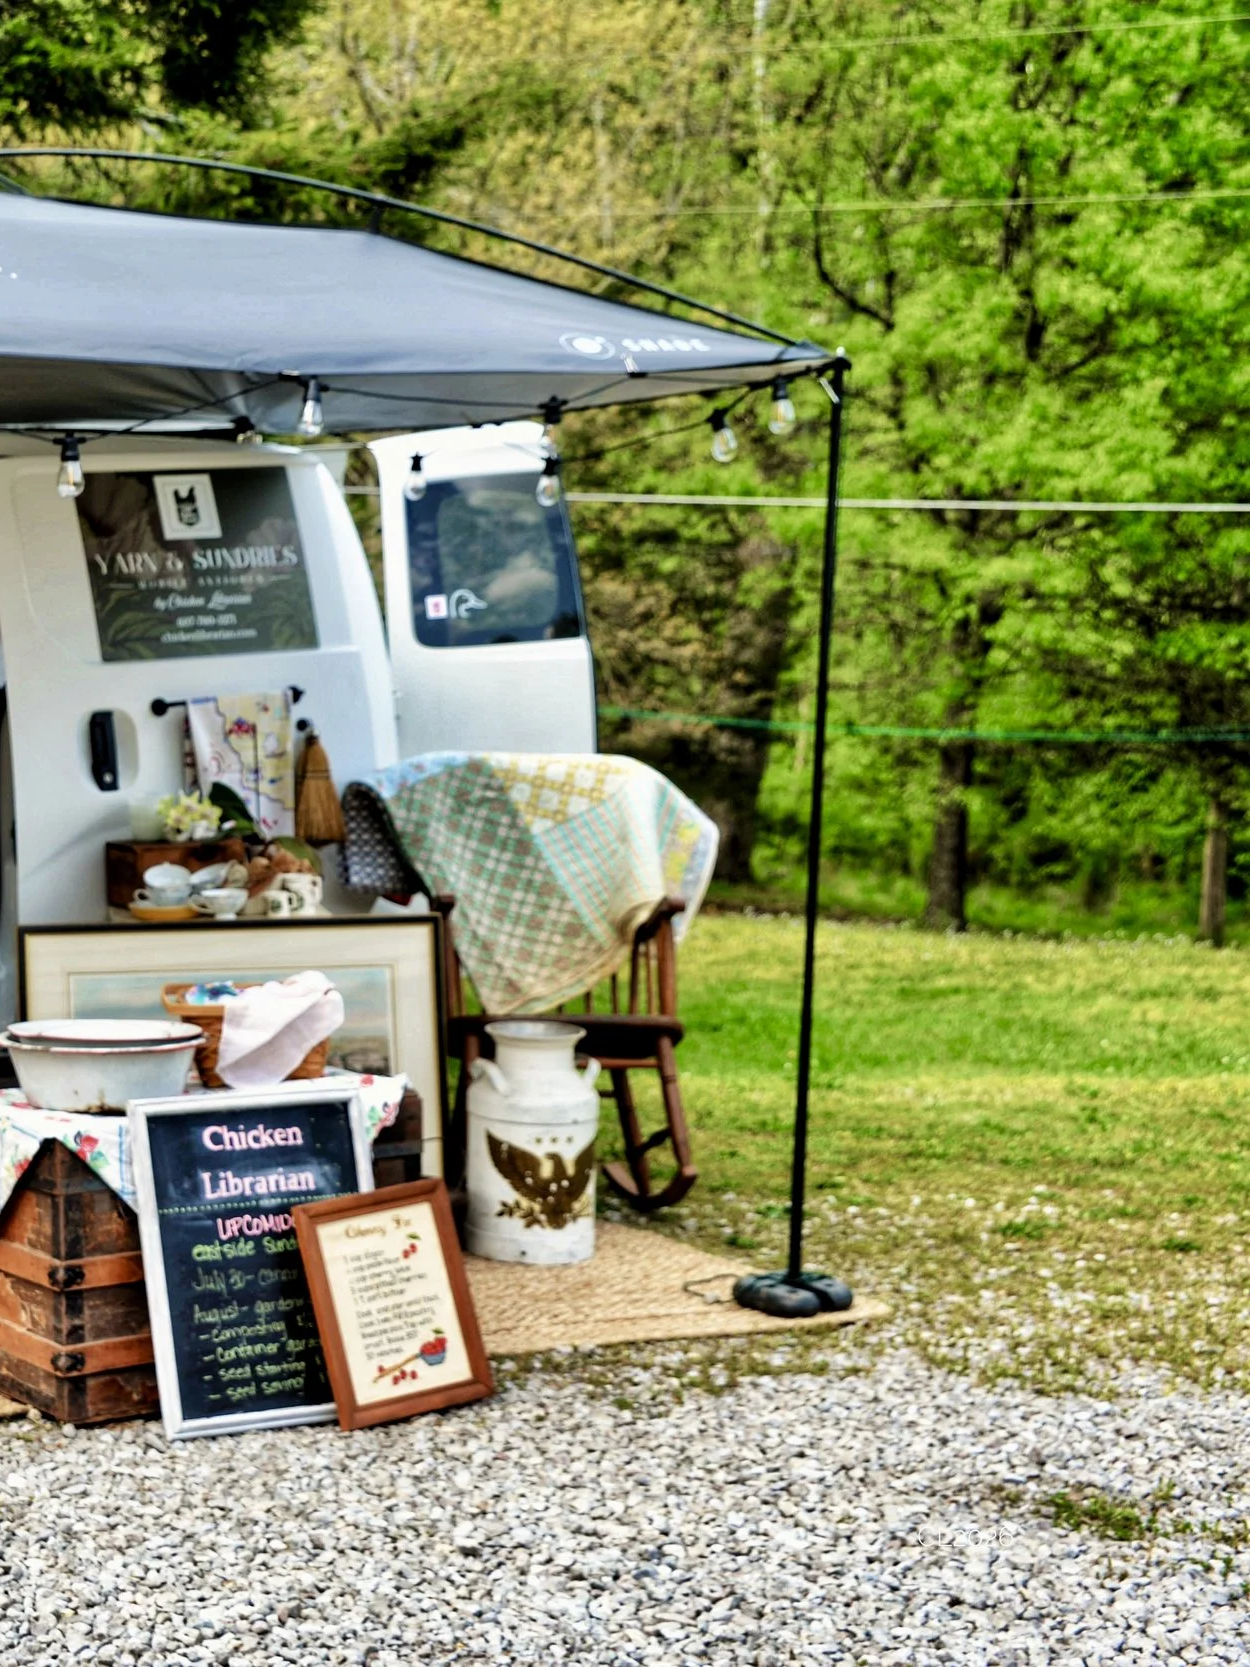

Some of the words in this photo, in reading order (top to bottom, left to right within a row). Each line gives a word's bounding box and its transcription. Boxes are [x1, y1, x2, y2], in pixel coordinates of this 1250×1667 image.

[94, 551, 158, 576] YARN
[164, 553, 184, 572] &
[192, 545, 299, 569] SUNDRIES
[202, 1123, 303, 1151] Chicken
[201, 1167, 316, 1200] Librarian
[190, 1266, 230, 1299] July
